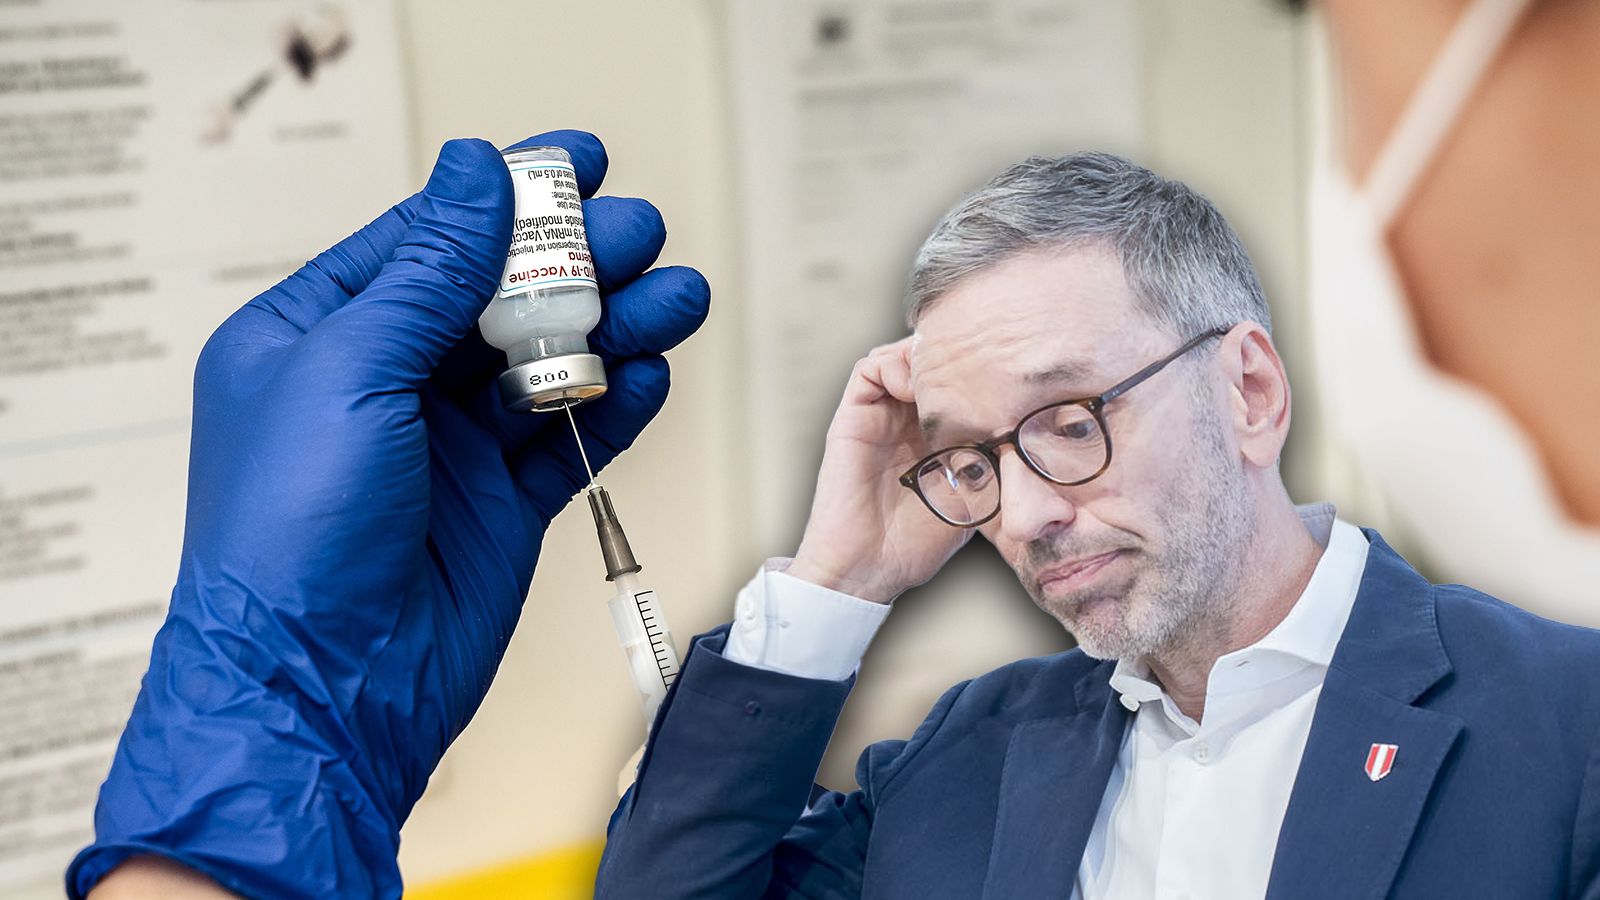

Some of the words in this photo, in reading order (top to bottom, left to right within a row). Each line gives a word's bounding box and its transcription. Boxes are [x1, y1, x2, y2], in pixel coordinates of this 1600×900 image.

[527, 169, 543, 180] mL)
[544, 169, 556, 179] 0.5
[556, 169, 563, 179] of
[553, 179, 564, 189] vial
[556, 201, 568, 210] Use
[515, 215, 562, 232] modified)
[543, 228, 572, 240] mRNA
[574, 228, 586, 240] -19
[507, 245, 534, 258] Injectio
[536, 243, 546, 252] for
[547, 240, 580, 252] Dispersion
[508, 265, 567, 283] Vaccine
